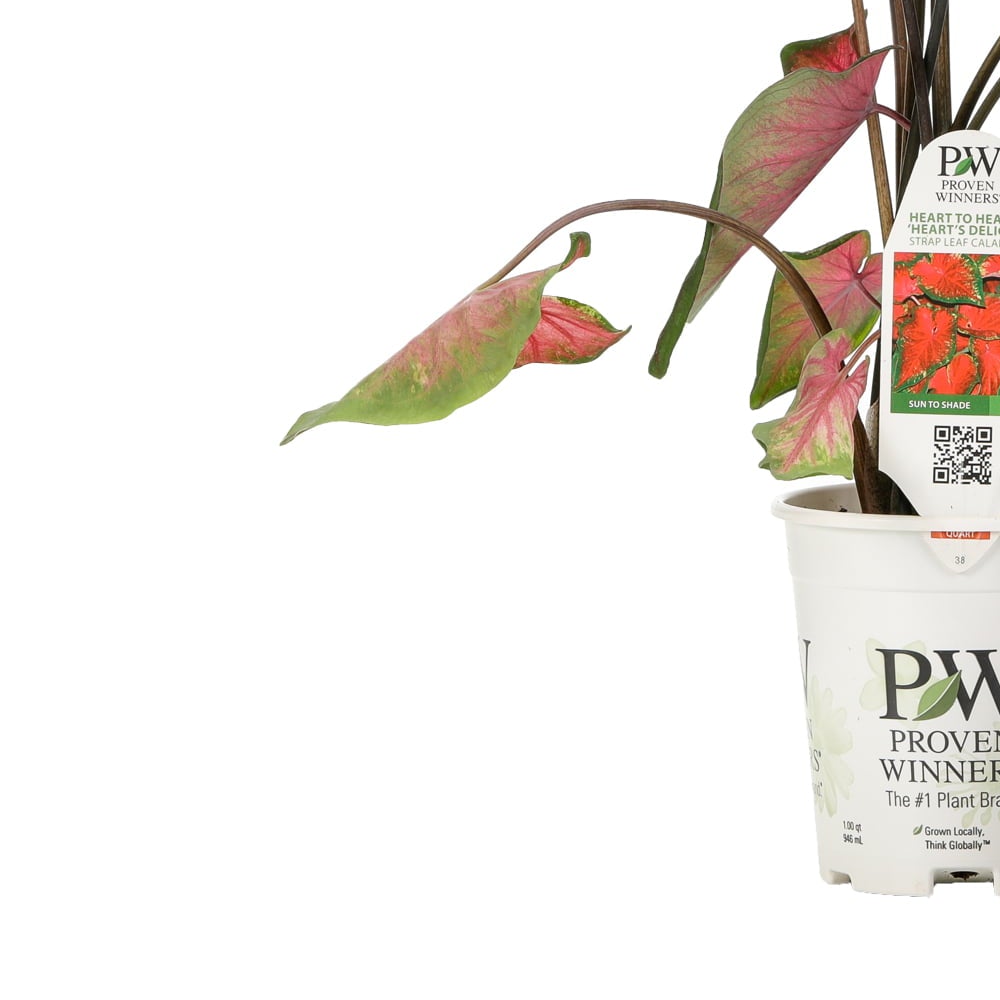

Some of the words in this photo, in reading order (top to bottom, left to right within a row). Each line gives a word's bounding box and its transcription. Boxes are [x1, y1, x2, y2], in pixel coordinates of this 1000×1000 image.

[942, 180, 994, 190] PROVEN
[909, 212, 953, 223] HEART
[955, 213, 973, 223] TO
[909, 236, 942, 246] STRAP
[944, 237, 969, 247] LEAF
[908, 400, 927, 409] SUN
[928, 400, 940, 409] TO
[941, 400, 971, 410] SHADE
[886, 790, 910, 808] The
[915, 792, 931, 808] #1
[938, 792, 975, 808] Plant
[843, 820, 855, 831] 1.00
[855, 823, 862, 833] qt
[924, 826, 951, 836] Grown
[953, 826, 985, 838] Locally,
[843, 833, 854, 844] 946
[854, 835, 864, 845] mL
[925, 840, 947, 850] Think
